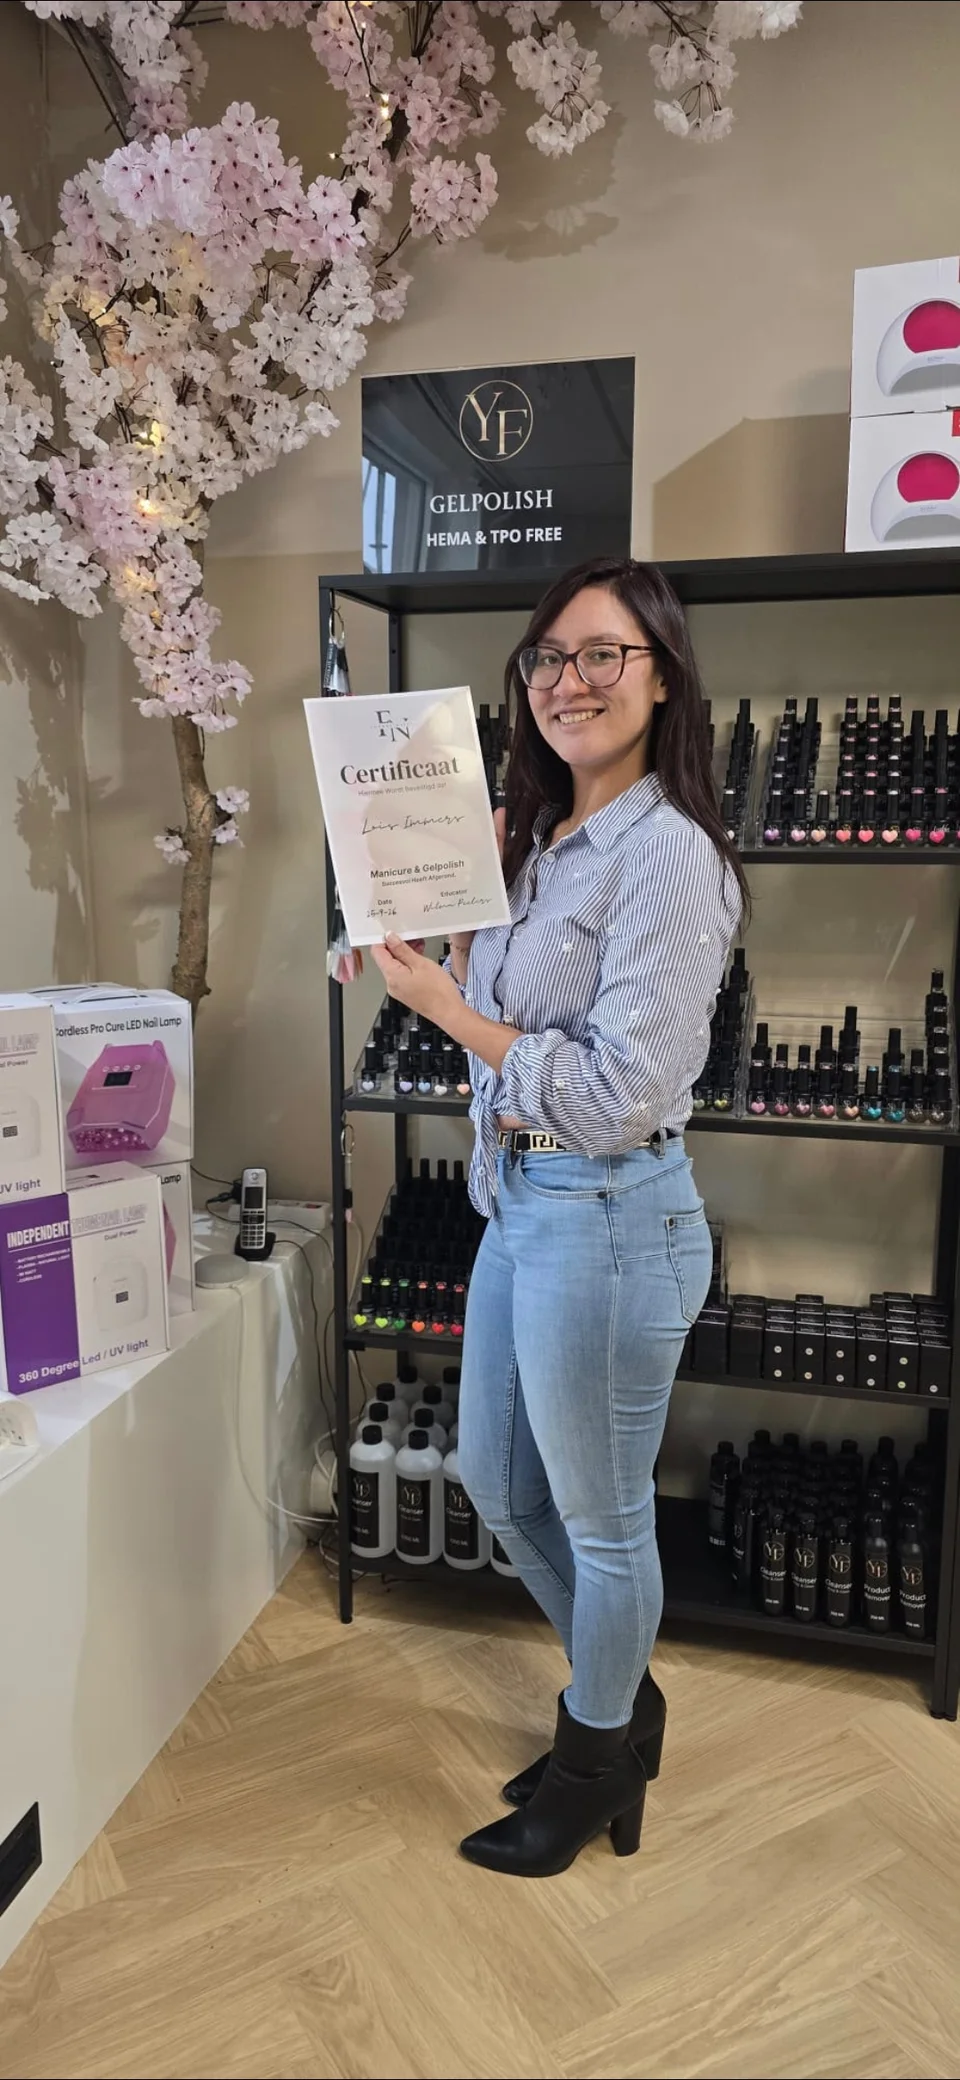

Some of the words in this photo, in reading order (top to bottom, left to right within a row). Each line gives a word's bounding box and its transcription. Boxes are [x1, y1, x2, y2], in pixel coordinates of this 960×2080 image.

[466, 392, 528, 456] YF
[429, 489, 553, 514] GELPOLISH
[427, 530, 471, 547] HEMA
[475, 530, 487, 544] &
[490, 529, 521, 544] TPO
[526, 526, 562, 542] FREE
[340, 757, 460, 785] Certificaat
[370, 866, 412, 879] Manicure
[414, 865, 421, 874] &
[423, 860, 464, 873] Gelpolish
[378, 898, 392, 906] Date
[90, 1024, 104, 1033] Pro
[105, 1022, 124, 1032] Cure
[126, 1020, 141, 1030] LED
[143, 1017, 158, 1028] Nail
[160, 1017, 182, 1029] Lamp
[16, 1179, 41, 1192] light
[160, 1174, 182, 1185] Lamp
[7, 1220, 70, 1248] INDEPENDENT
[19, 1370, 39, 1383] 360
[41, 1359, 79, 1378] Degree
[82, 1354, 101, 1365] Led
[109, 1345, 124, 1357] UV
[127, 1339, 149, 1354] light
[864, 1583, 891, 1594] Product
[899, 1589, 927, 1601] Product
